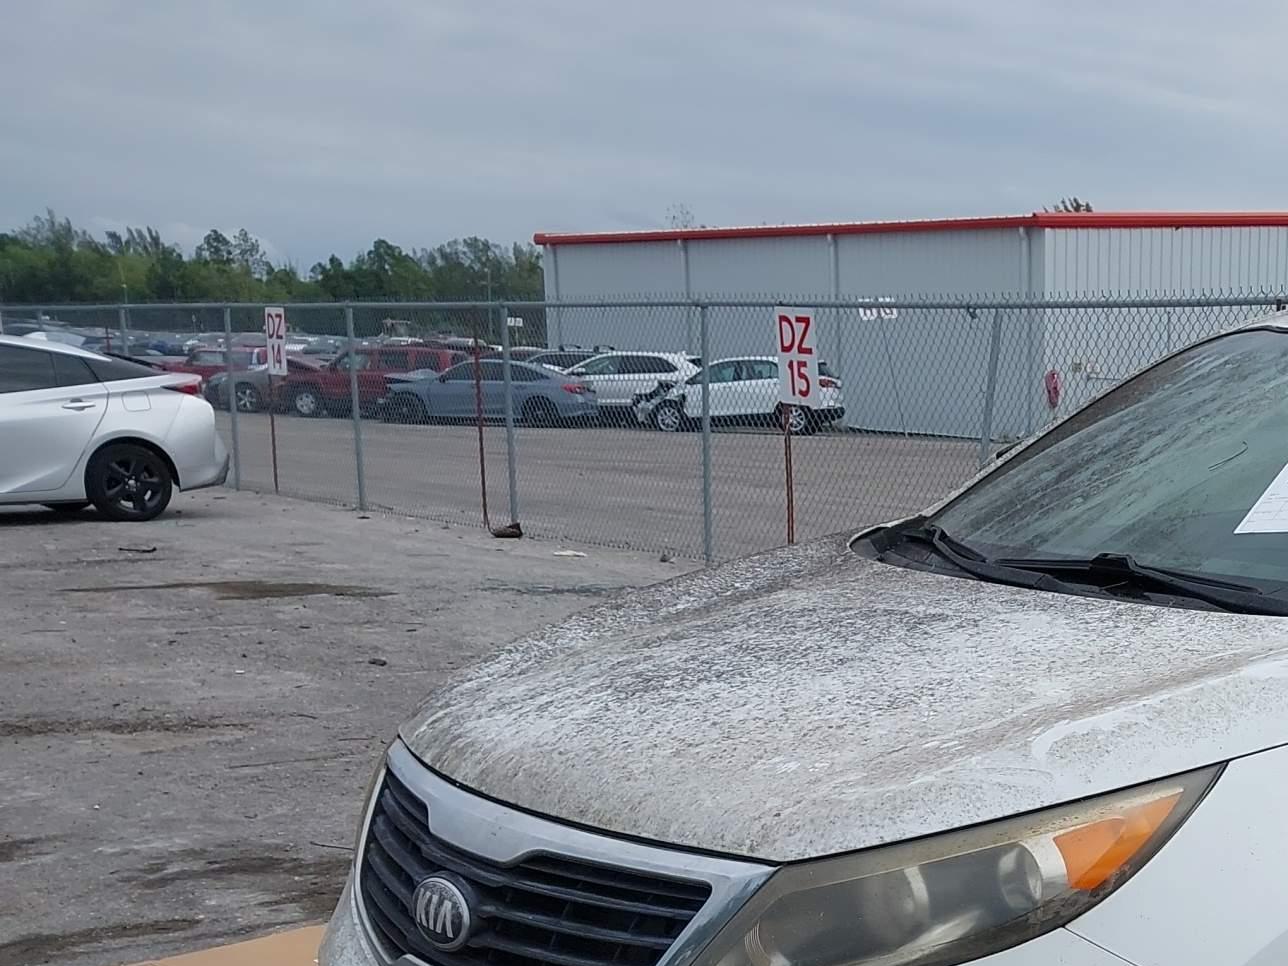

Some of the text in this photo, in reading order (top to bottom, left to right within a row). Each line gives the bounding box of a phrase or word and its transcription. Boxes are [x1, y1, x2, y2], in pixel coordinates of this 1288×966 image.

[267, 313, 283, 339] DZ
[778, 315, 813, 355] DZ
[271, 344, 282, 369] 14
[787, 359, 811, 398] 15
